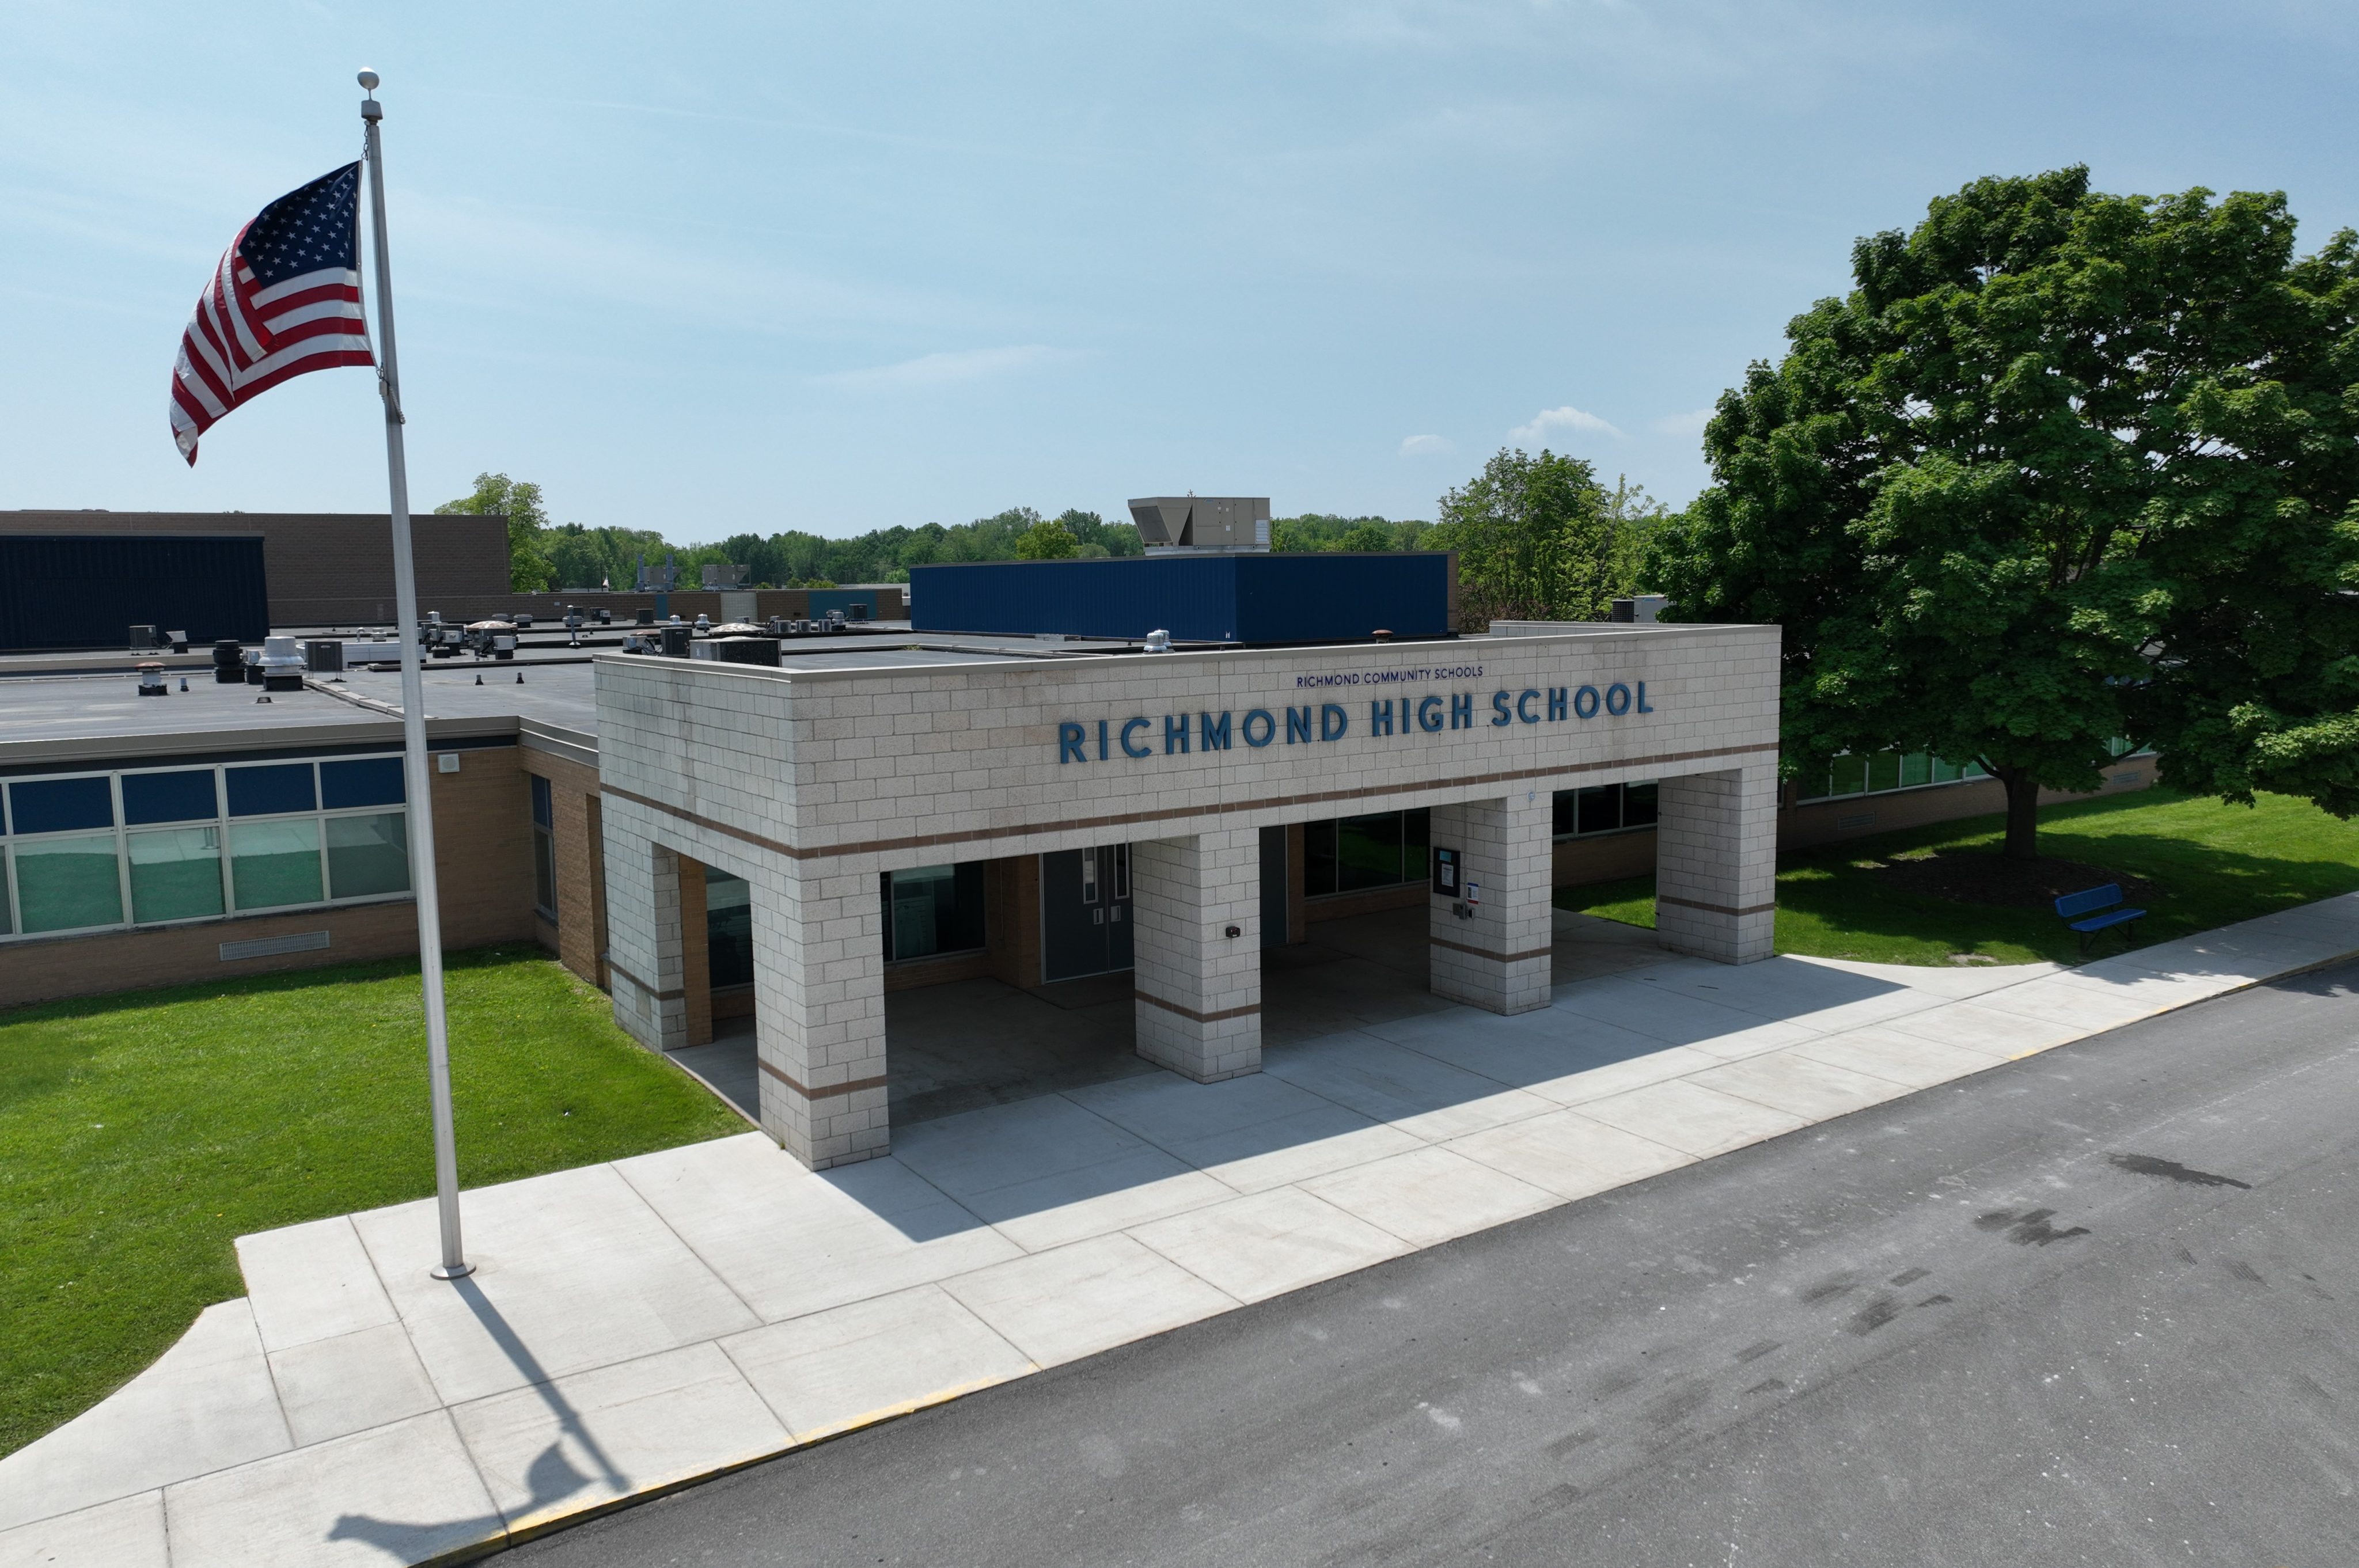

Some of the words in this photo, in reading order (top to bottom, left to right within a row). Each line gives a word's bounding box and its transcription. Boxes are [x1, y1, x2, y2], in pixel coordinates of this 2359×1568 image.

[1297, 674, 1360, 688] RICHMOND
[1364, 669, 1431, 684] COMMUNITY
[1435, 666, 1484, 679] SCHOOLS
[1059, 704, 1348, 764] RICHMOND
[1371, 694, 1473, 737] HIGH
[1491, 681, 1654, 727] SCHOOL
